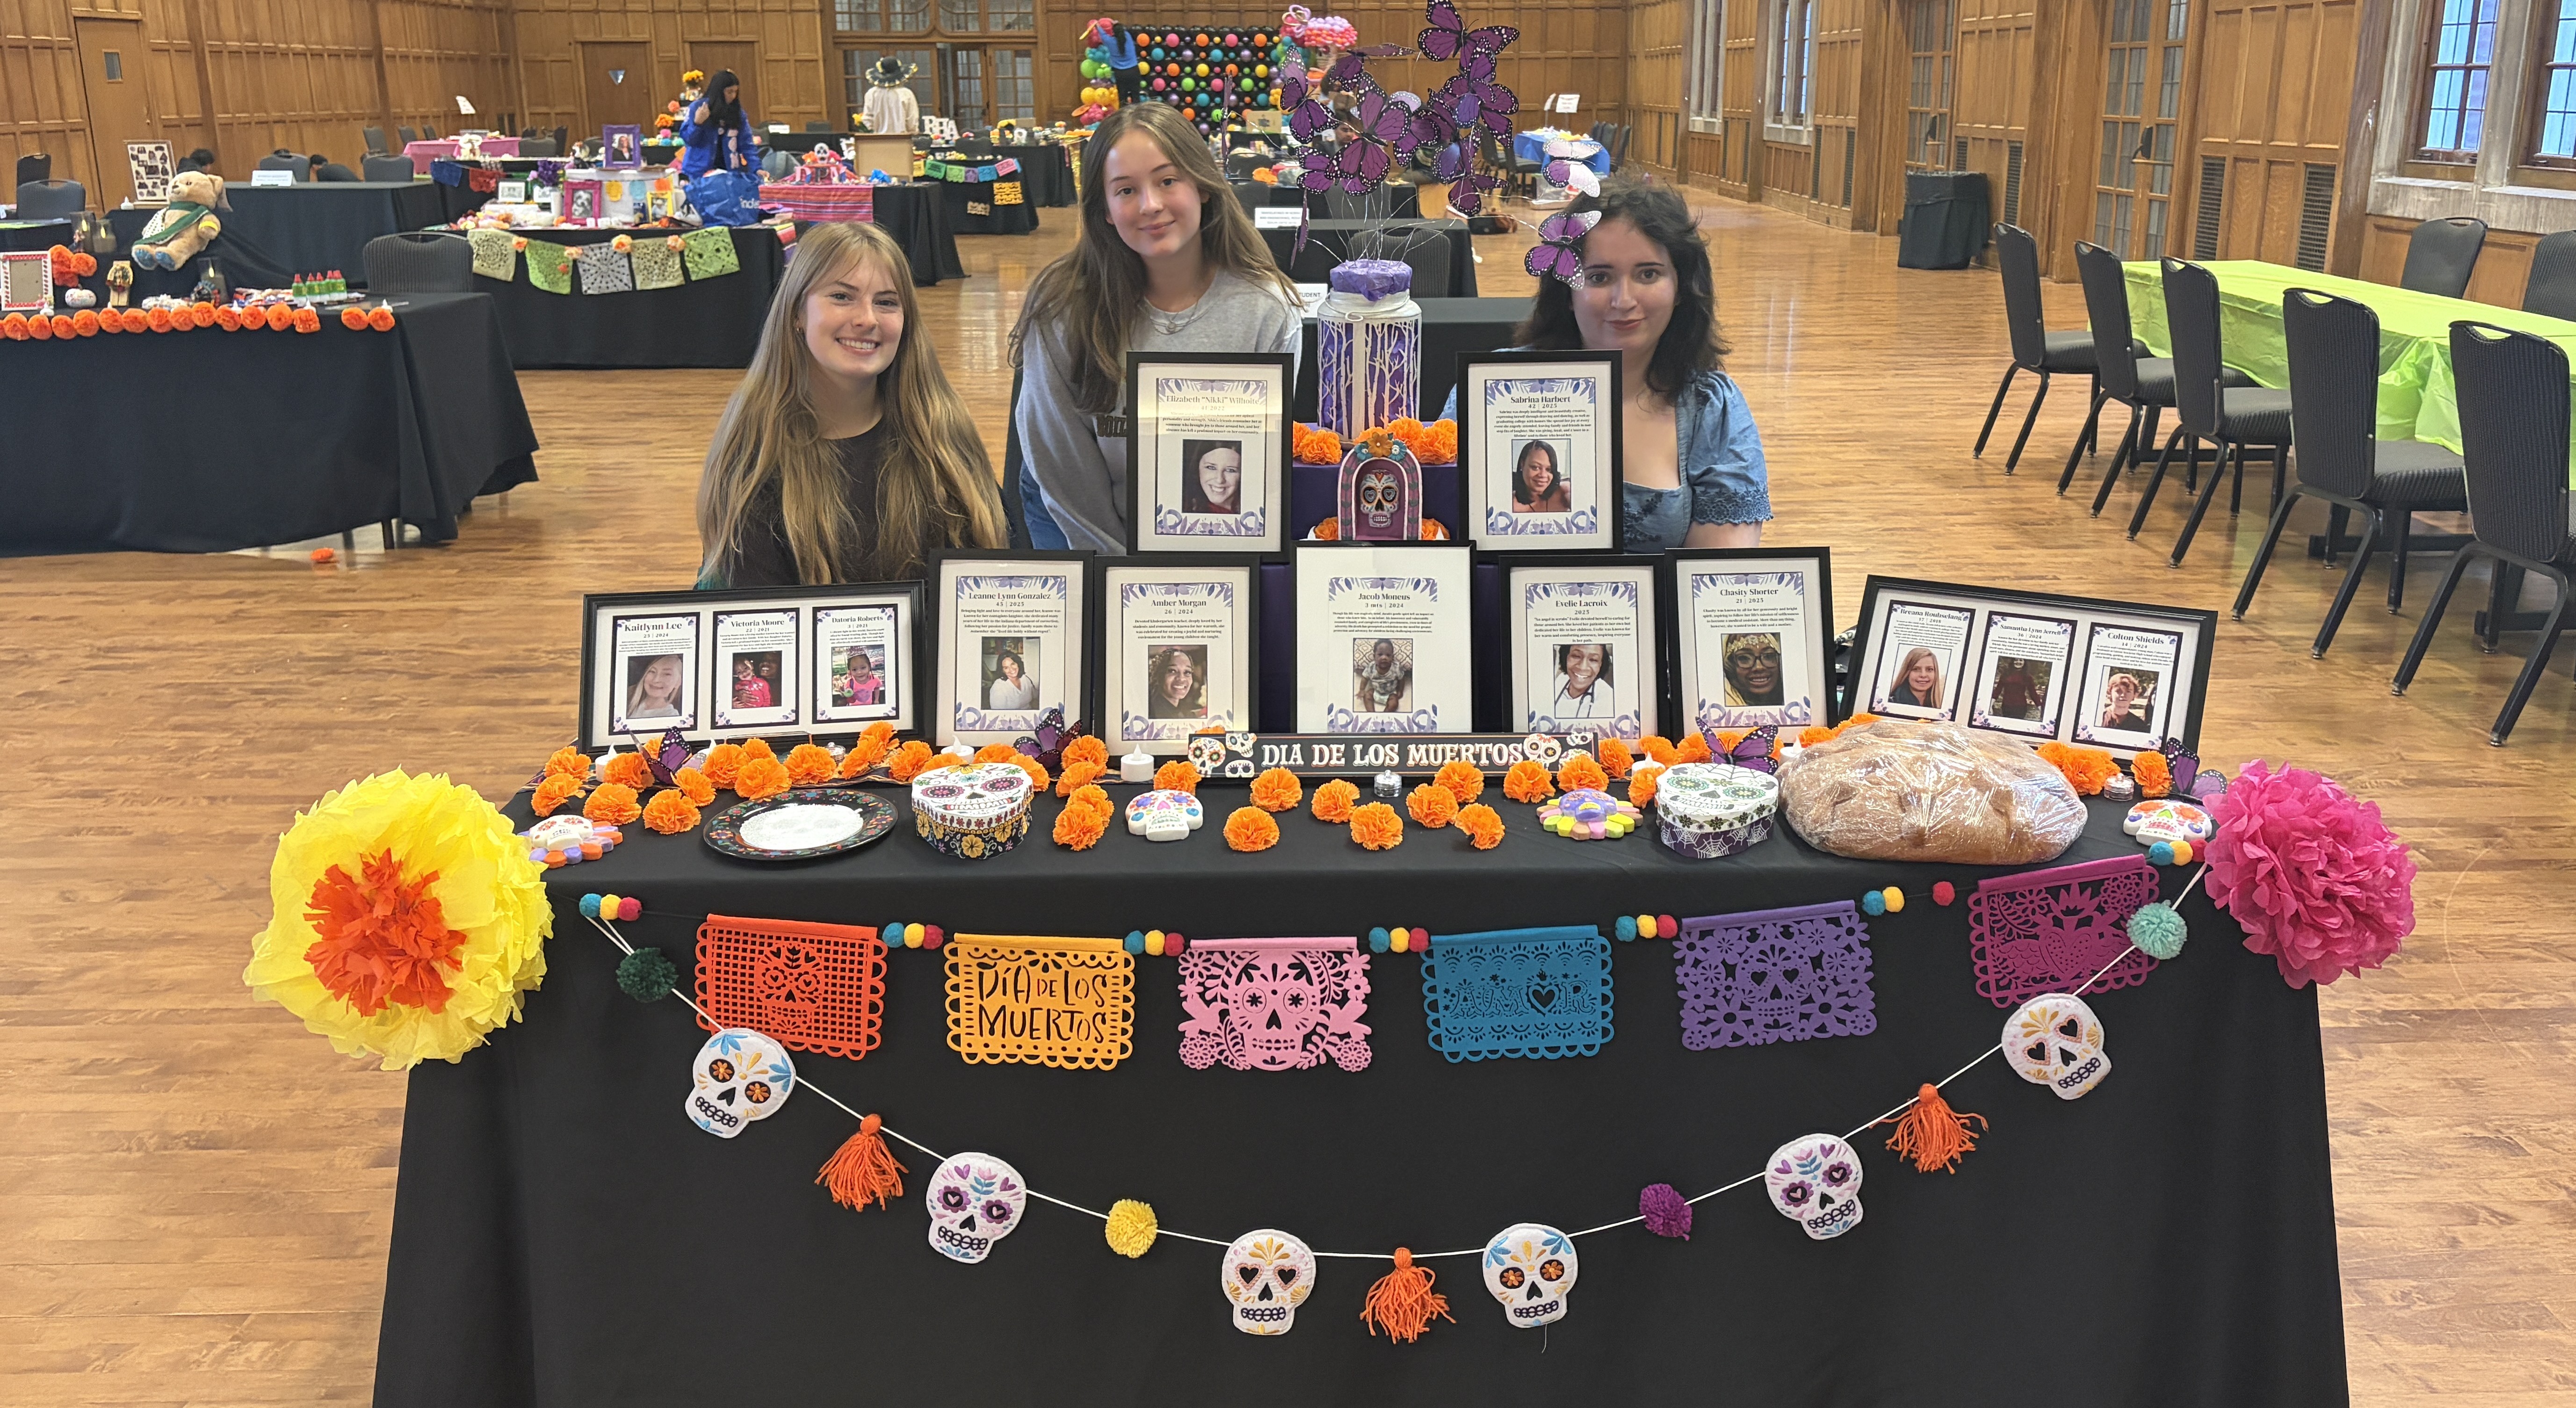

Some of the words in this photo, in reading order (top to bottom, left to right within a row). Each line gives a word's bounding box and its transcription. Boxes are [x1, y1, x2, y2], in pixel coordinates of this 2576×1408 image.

[625, 624, 664, 632] Kaitlynn
[2107, 632, 2134, 641] Colton
[2135, 635, 2164, 645] Shields
[1261, 743, 1304, 767] DIA
[1311, 743, 1345, 767] DE
[1353, 743, 1400, 766] LOS
[1407, 743, 1523, 767] MUERTOS
[1037, 978, 1058, 997] DE
[1064, 970, 1107, 1008] LOS
[978, 1003, 1107, 1044] MUERTOS
